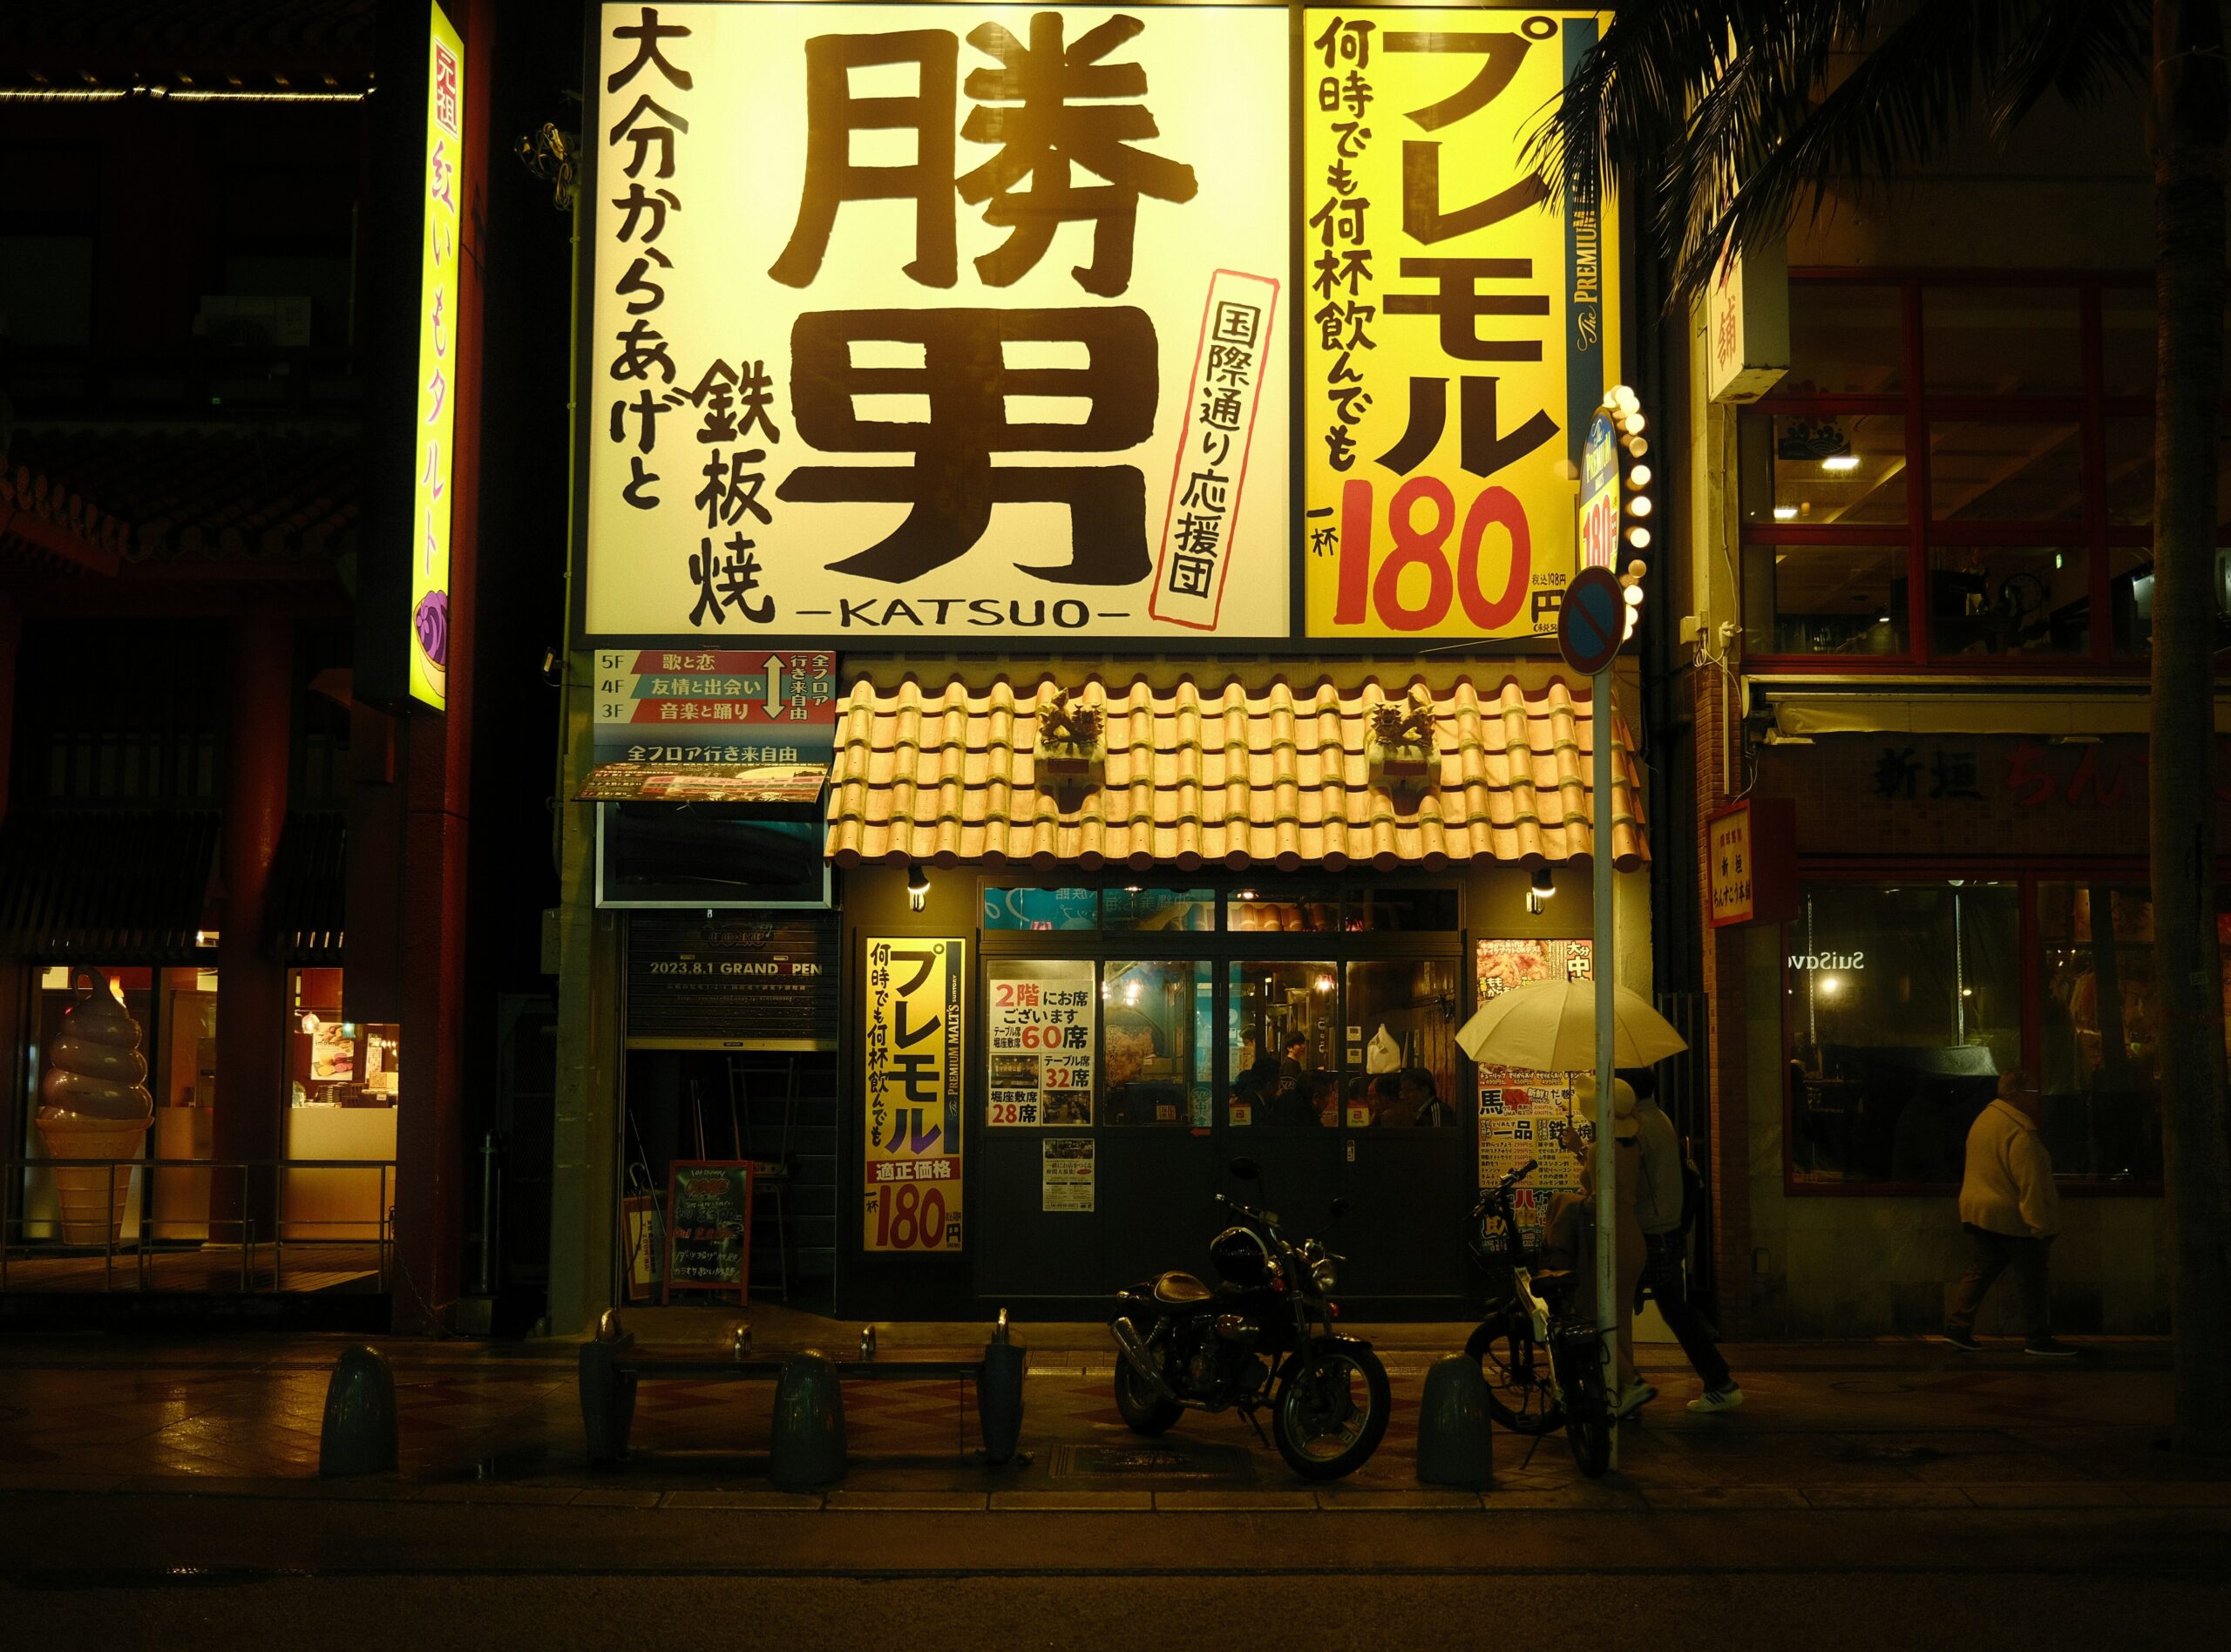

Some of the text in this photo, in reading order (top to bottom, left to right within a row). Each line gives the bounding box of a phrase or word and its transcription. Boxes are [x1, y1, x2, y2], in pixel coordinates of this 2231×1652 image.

[437, 50, 458, 131] 元祖
[607, 7, 693, 509] 大分からあげと
[1309, 15, 1376, 472] 何時でも何杯飲んでも
[1373, 16, 1561, 478] プレモル
[767, 10, 1198, 586] 勝男
[1577, 305, 1597, 351] The
[423, 140, 455, 577] 紅いもタルト
[1170, 301, 1262, 599] 国際通り応援団
[688, 358, 780, 626] 鉄板焼
[1306, 475, 1531, 631] 一杯 180
[1532, 572, 1566, 586] 税込198円
[602, 654, 715, 671] 5F 歌と恋
[601, 679, 761, 695] 4F 友情と出会い
[790, 654, 808, 721] 行き来自由
[812, 654, 830, 707] 全フロア
[602, 702, 749, 720] 3F 音楽と踊り
[627, 745, 797, 762] 全フロア行き来自由
[2004, 742, 2149, 807] ちん
[1567, 942, 1590, 957] 大分
[650, 963, 822, 976] 2023.8.1 GRAND PEN
[995, 983, 1088, 1008] 2階にお席
[946, 1004, 959, 1045] MALT'S
[993, 1026, 1021, 1037] テーブル席
[1004, 1009, 1078, 1025] ございます
[867, 942, 891, 1148] 何時でも何杯飲んでも
[884, 943, 945, 1154] プレモル
[1021, 1025, 1088, 1049] 60席
[947, 1047, 959, 1095] PREMIUM
[1045, 1055, 1090, 1066] テーブル席
[1046, 1068, 1089, 1087] 32席
[993, 1104, 1037, 1123] 28席
[1480, 1089, 1504, 1115] 馬
[1494, 1121, 1532, 1140] 一品
[1549, 1121, 1590, 1141] 鉄焼
[876, 1161, 952, 1181] 適正価格
[865, 1192, 878, 1213] 一杯
[876, 1183, 946, 1249] 180
[946, 1223, 961, 1242] 円
